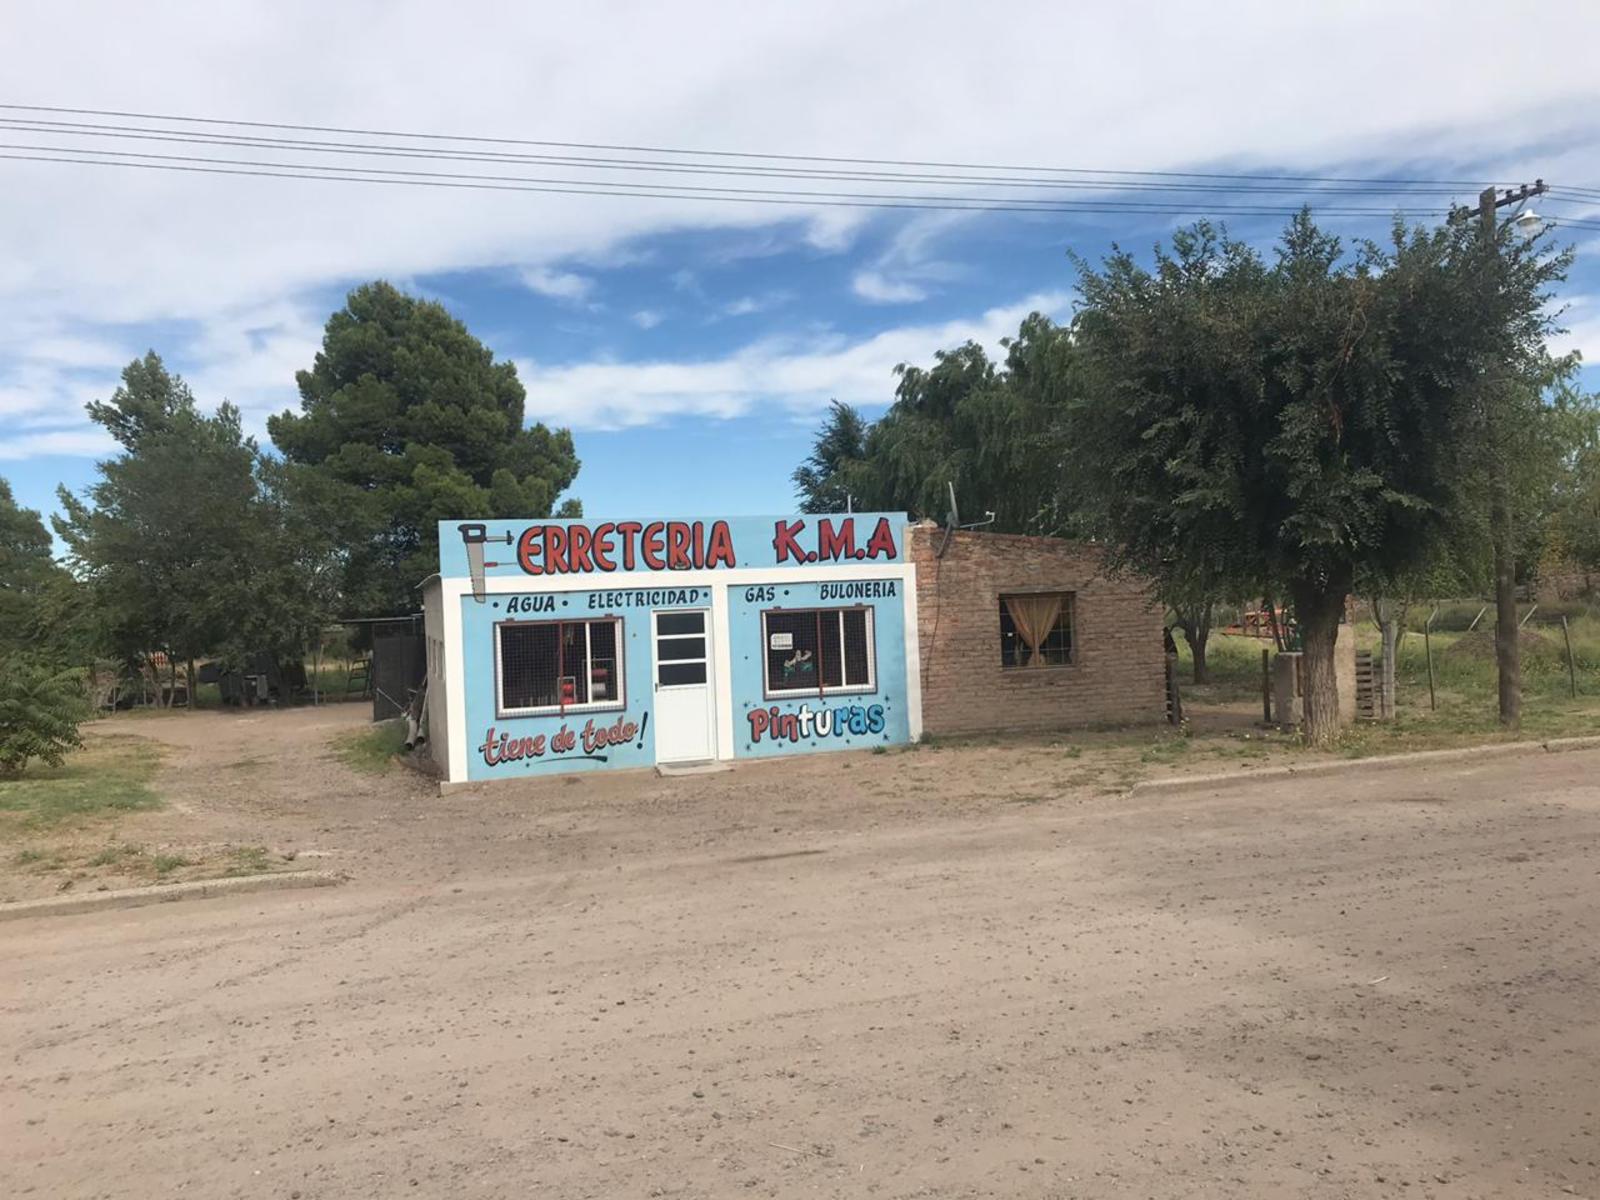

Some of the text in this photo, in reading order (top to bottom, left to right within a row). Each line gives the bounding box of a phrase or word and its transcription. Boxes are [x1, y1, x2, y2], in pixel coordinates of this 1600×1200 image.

[772, 517, 897, 565] K.M.A
[506, 581, 896, 613] AGUA ELECTRICIDAD GAS BULONERIA
[747, 704, 885, 743] Pinturas
[478, 725, 546, 766] tiene
[551, 723, 576, 752] de
